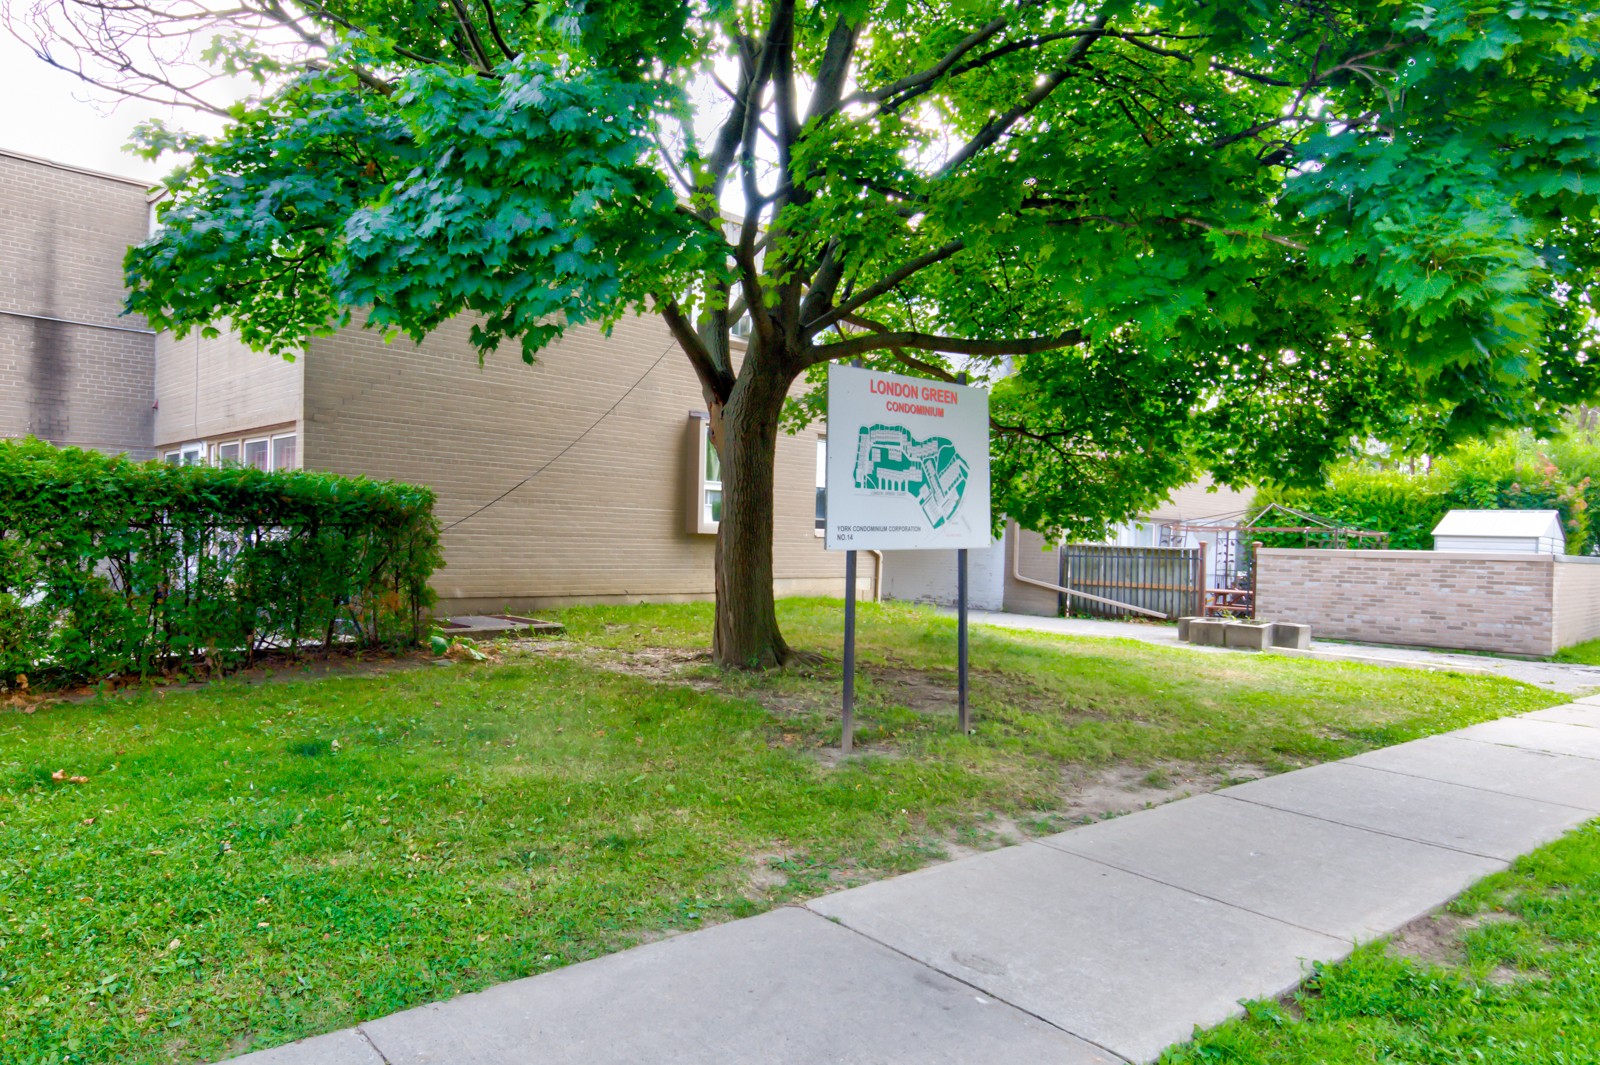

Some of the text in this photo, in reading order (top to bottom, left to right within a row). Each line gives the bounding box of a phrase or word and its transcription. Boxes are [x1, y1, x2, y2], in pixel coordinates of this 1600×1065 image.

[870, 378, 958, 404] LONDON GREEN
[886, 400, 944, 417] CONDOMINIUM
